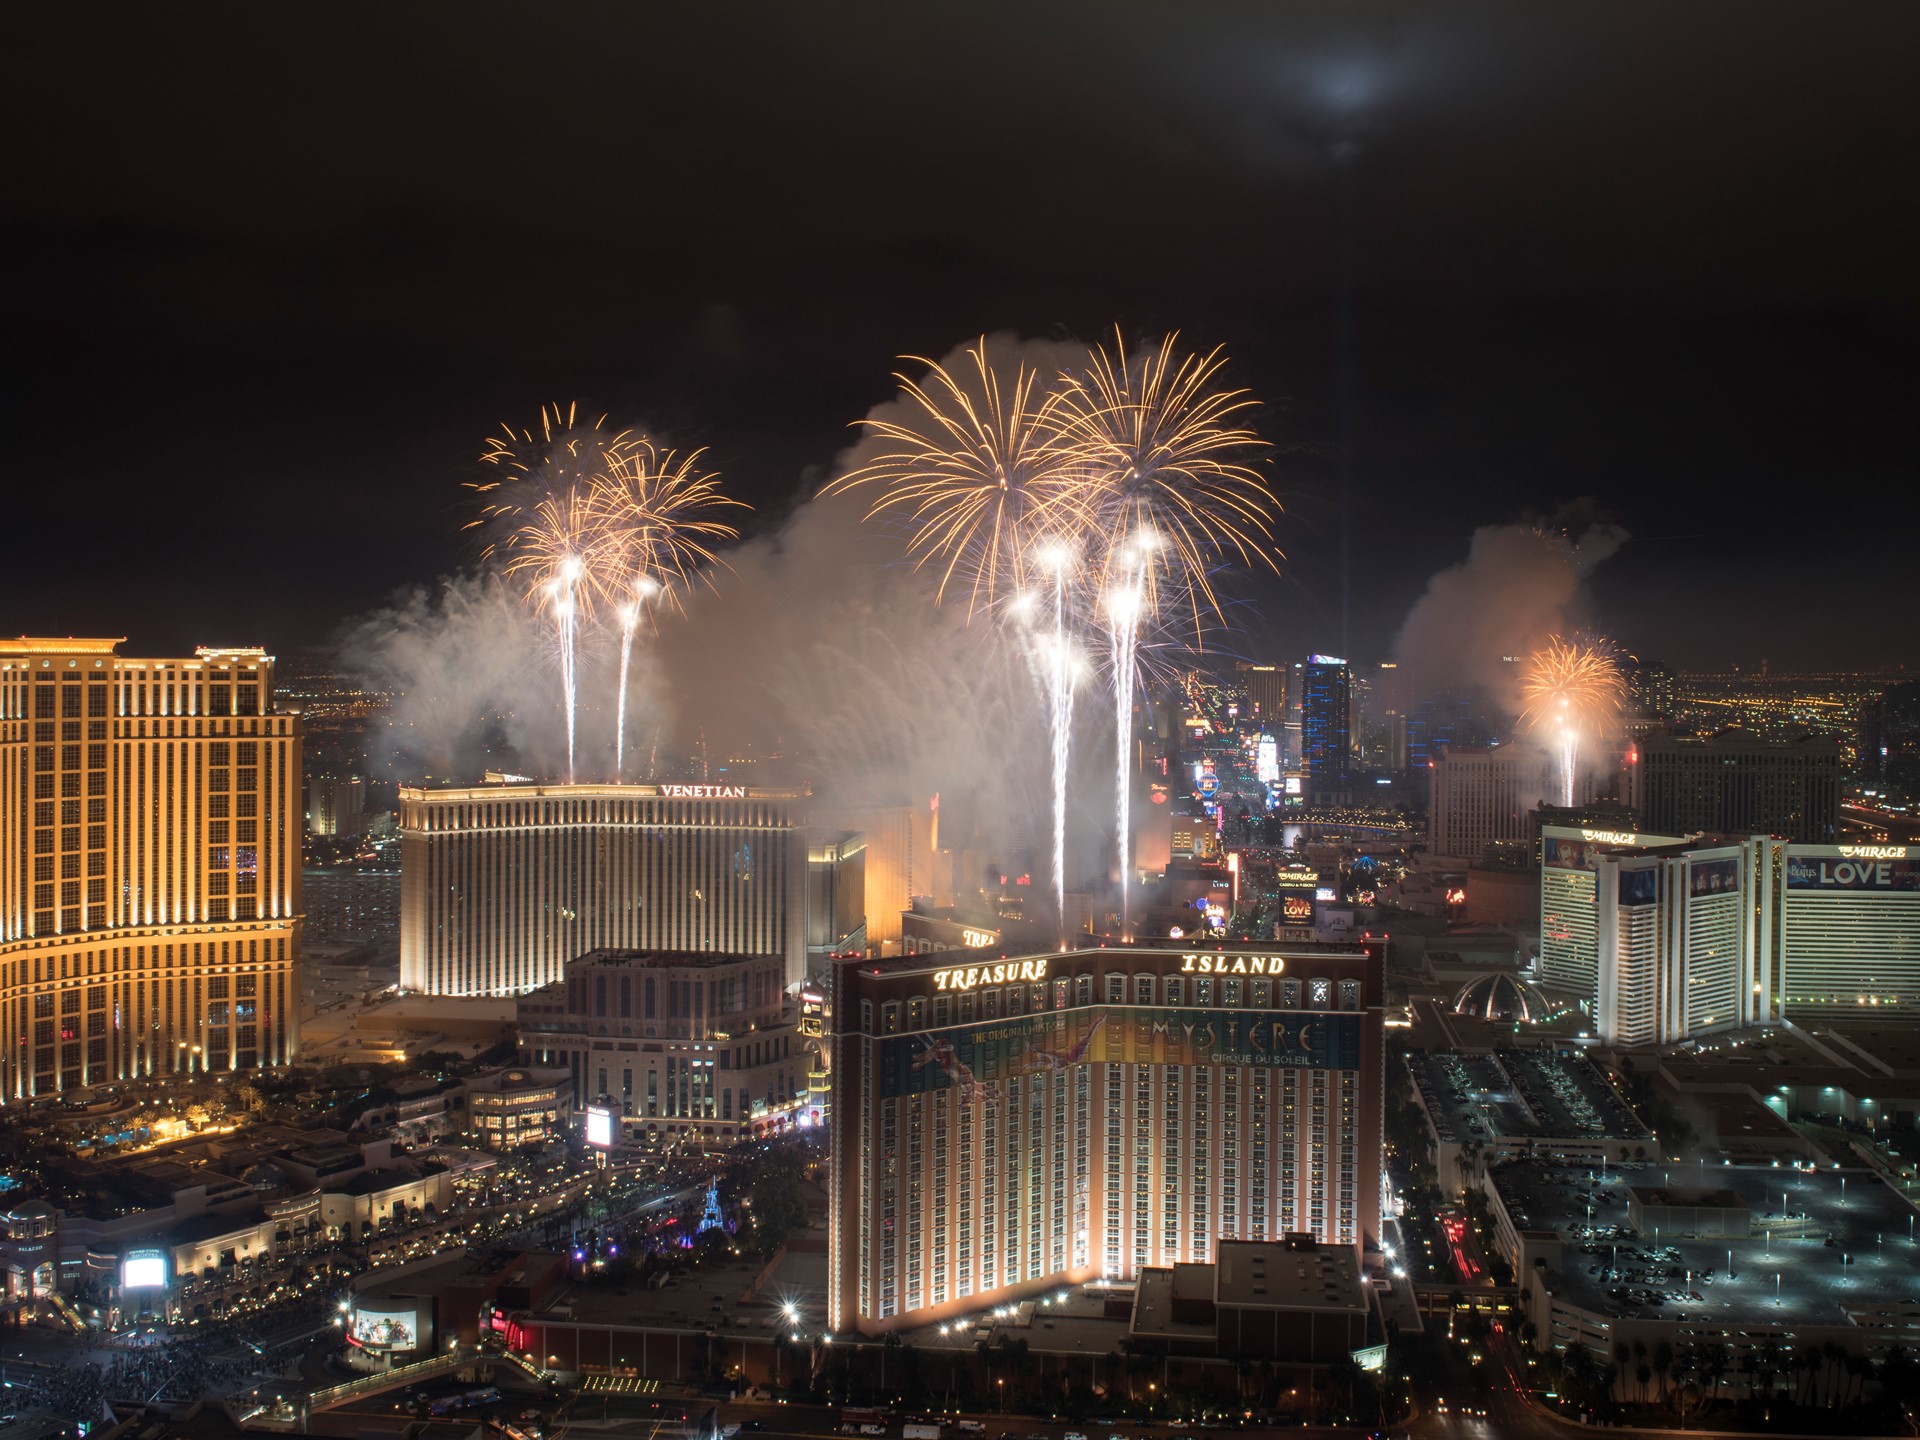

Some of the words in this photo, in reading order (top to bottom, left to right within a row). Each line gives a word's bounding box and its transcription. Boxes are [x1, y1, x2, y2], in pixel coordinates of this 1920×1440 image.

[661, 785, 746, 798] VENETIAN
[1585, 830, 1636, 844] MIRAGE
[1843, 846, 1907, 859] MIRAGE
[1280, 872, 1318, 881] MIRAGE
[1820, 862, 1892, 884] LOVE
[1283, 906, 1311, 916] LOVE
[1181, 954, 1285, 974] ISLAND
[934, 959, 1047, 990] TREASURE
[971, 1031, 987, 1044] THE
[988, 1025, 1027, 1041] ORIGINAL
[1211, 1053, 1252, 1065] CIRQUE
[1255, 1054, 1271, 1065] DU
[1273, 1055, 1311, 1066] SOLEIL
